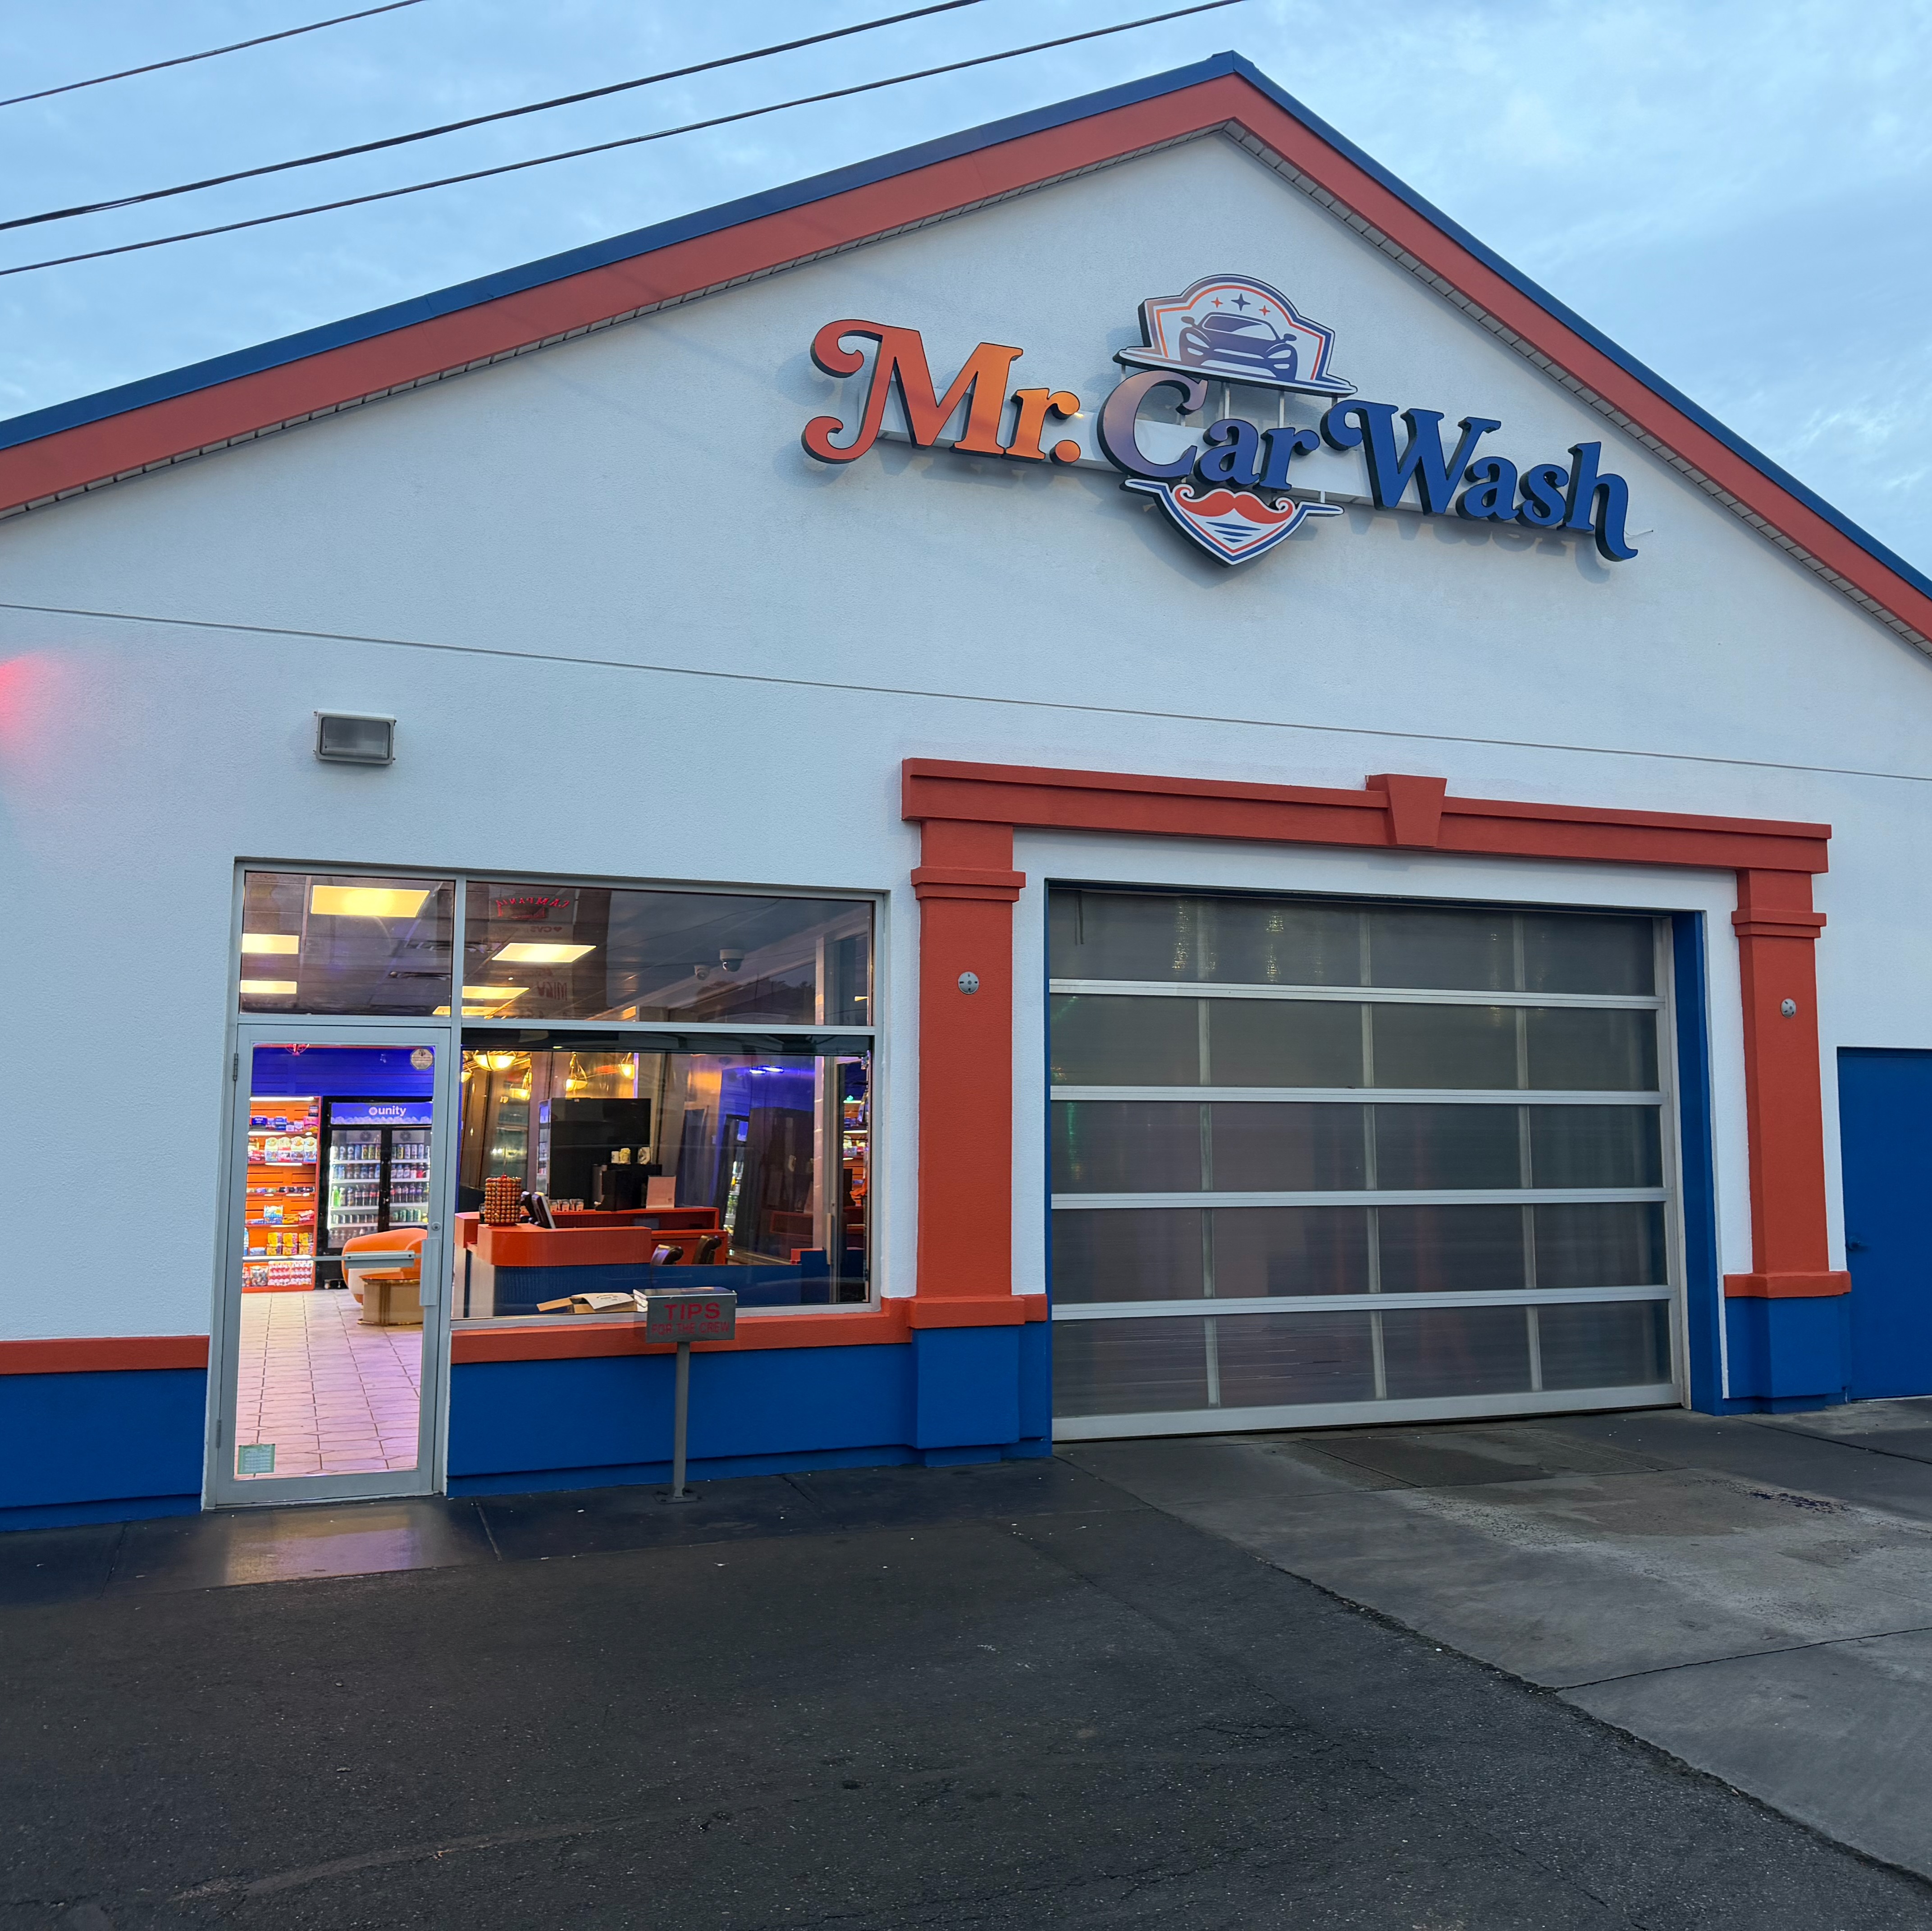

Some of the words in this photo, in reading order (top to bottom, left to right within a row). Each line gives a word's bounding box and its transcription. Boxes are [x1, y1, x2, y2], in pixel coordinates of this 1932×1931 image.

[803, 319, 1081, 464] Mr.
[1098, 371, 1320, 490] Car
[1321, 399, 1638, 561] Wash
[379, 1106, 406, 1117] unity
[664, 1302, 721, 1320] TIPS
[652, 1324, 673, 1336] FOR
[676, 1322, 696, 1334] THE
[699, 1321, 730, 1334] CREW
